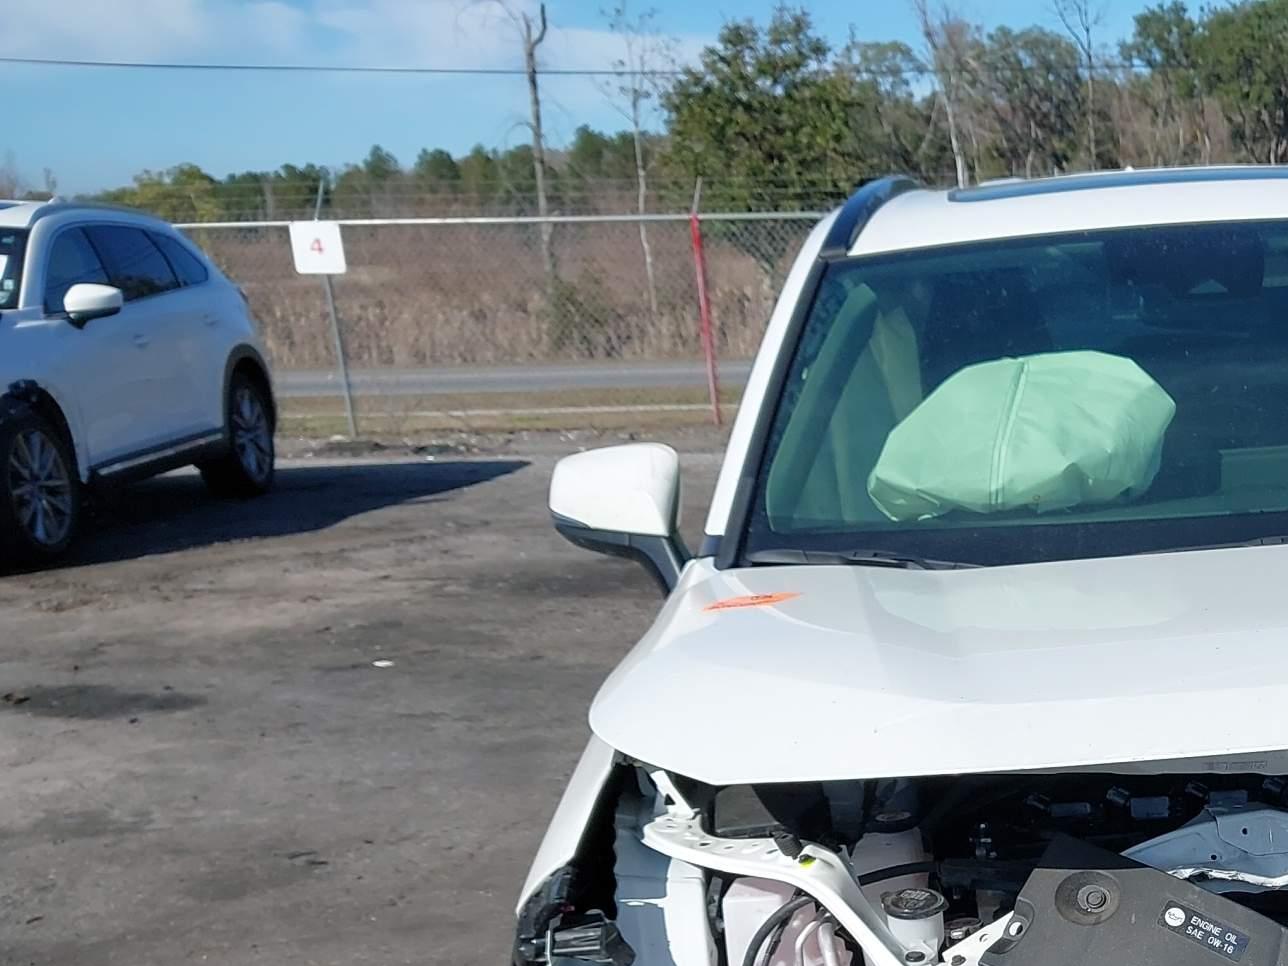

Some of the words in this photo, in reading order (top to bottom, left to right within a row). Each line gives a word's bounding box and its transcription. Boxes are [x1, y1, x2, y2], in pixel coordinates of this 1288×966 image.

[310, 238, 324, 256] 4
[1185, 925, 1205, 940] SAE
[1207, 936, 1234, 954] 0W-16
[1190, 915, 1223, 936] ENGINE
[1224, 932, 1238, 945] OIL
